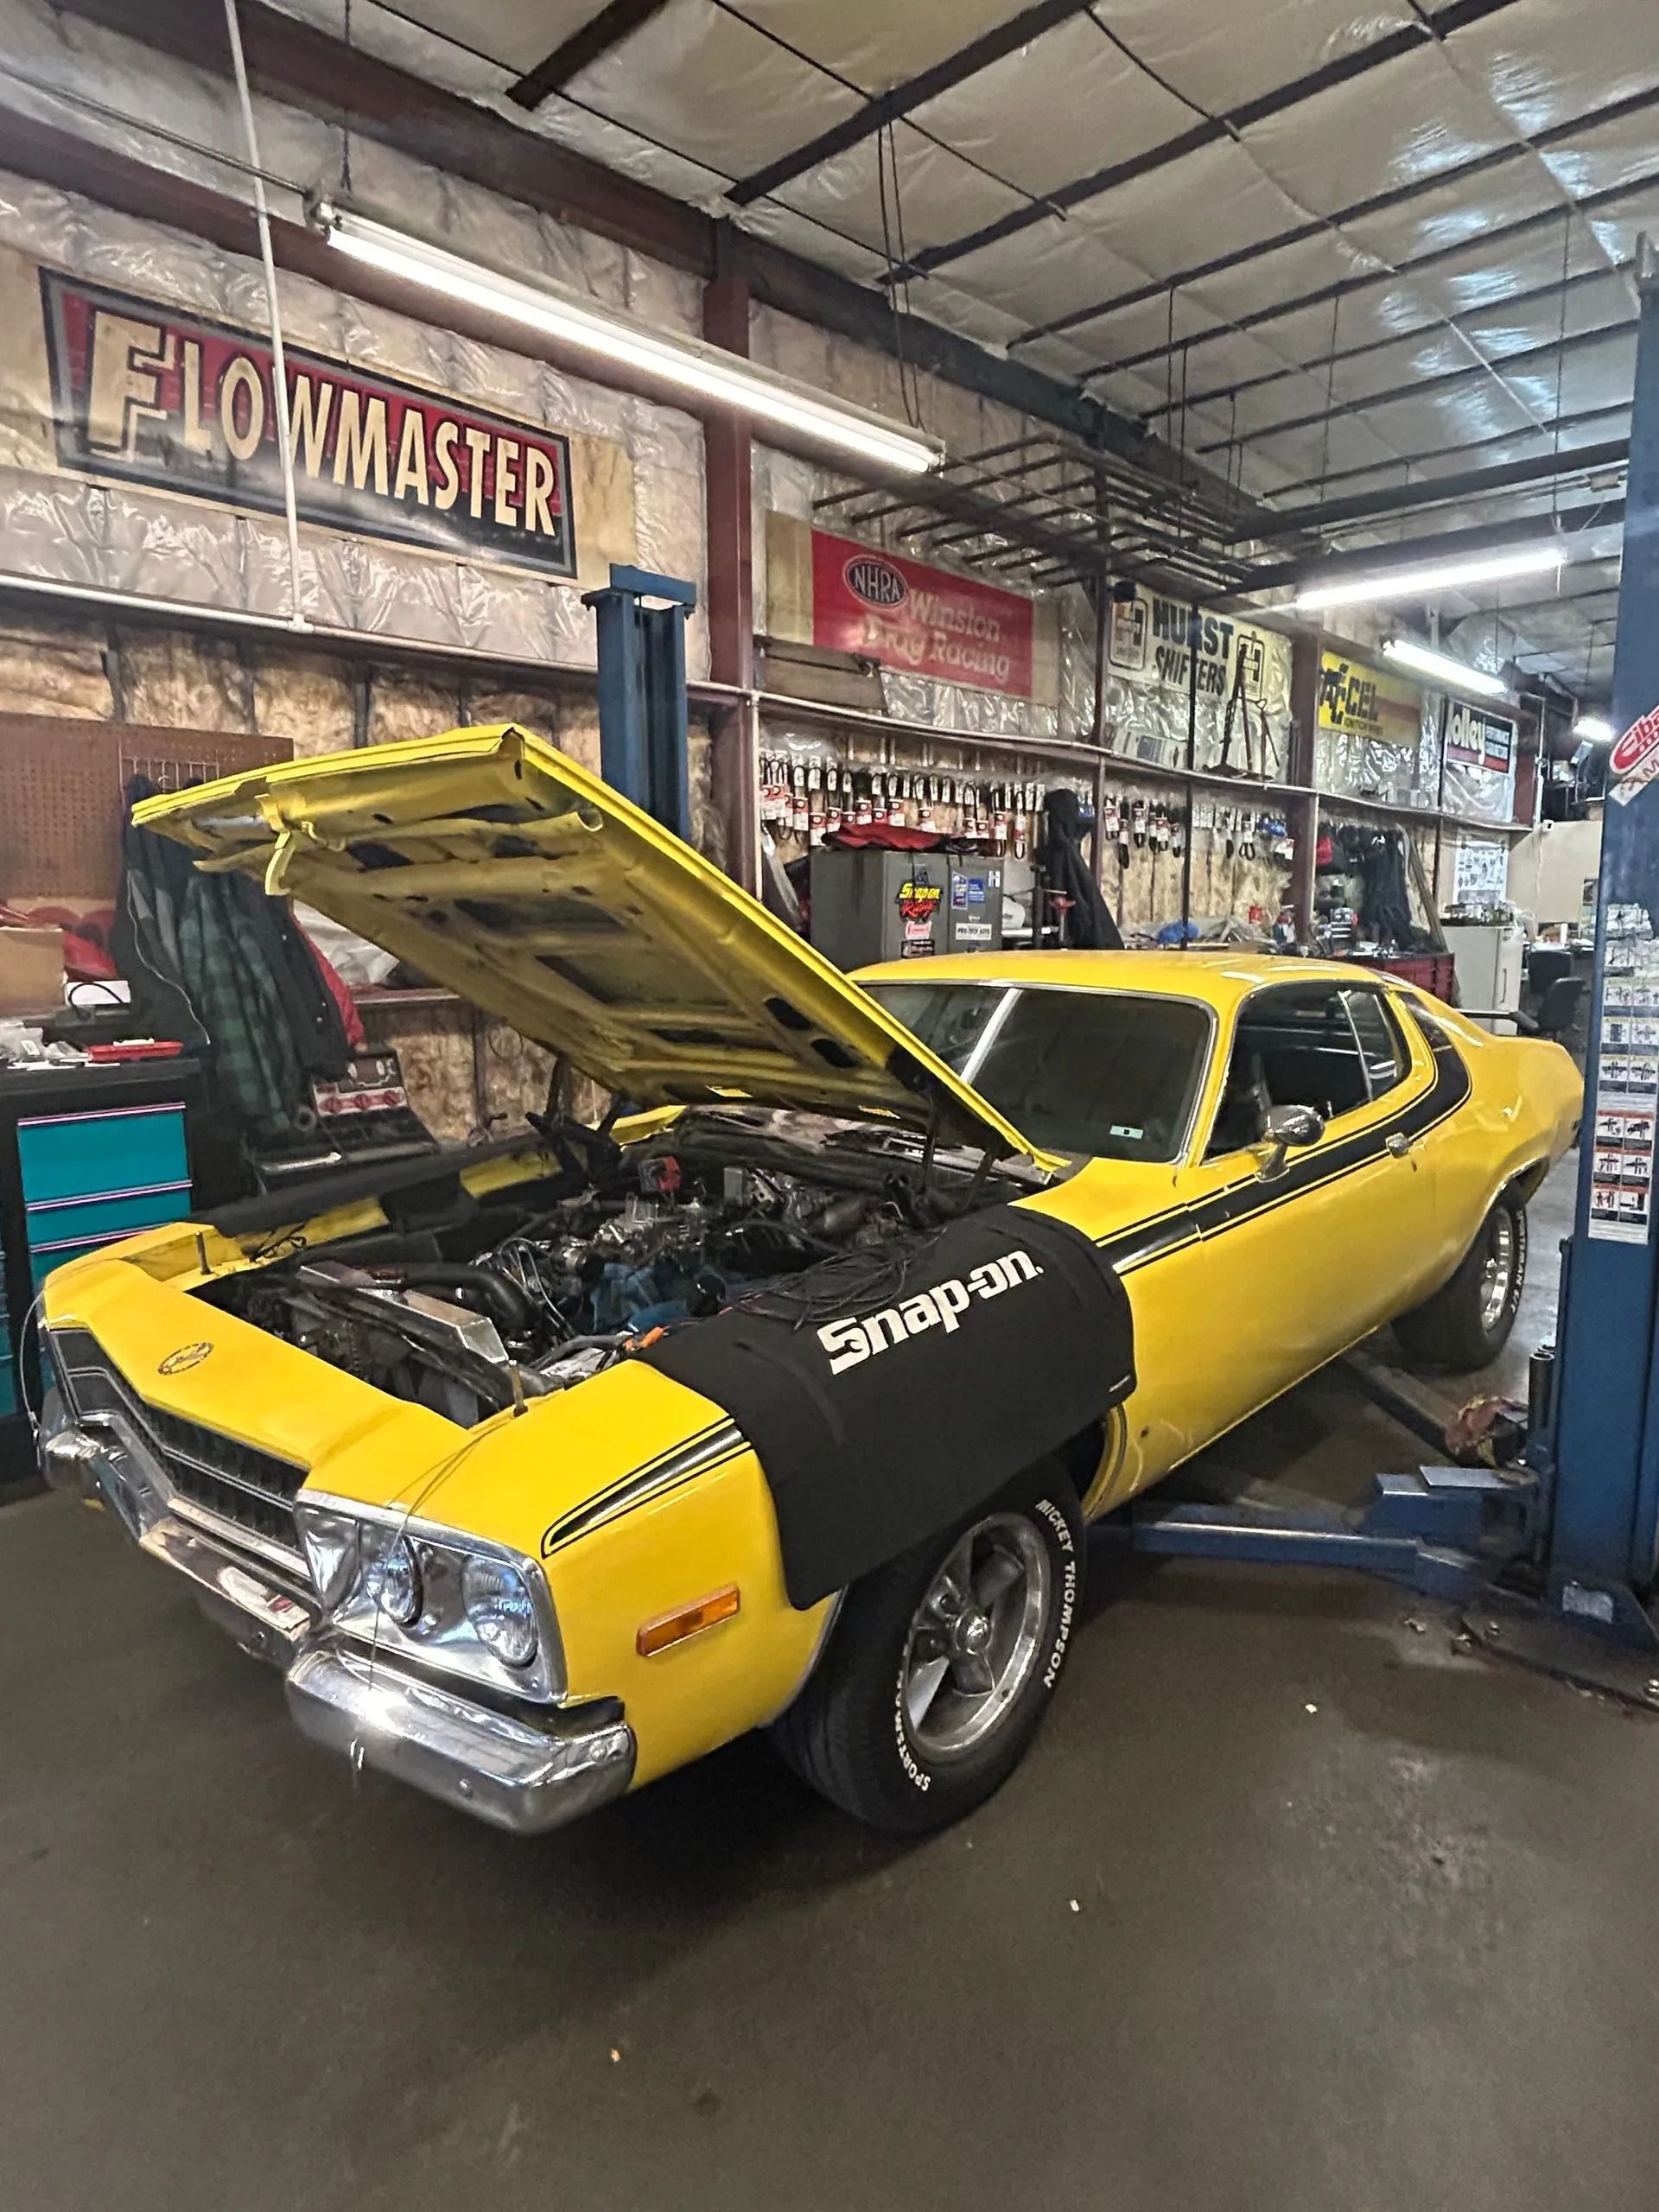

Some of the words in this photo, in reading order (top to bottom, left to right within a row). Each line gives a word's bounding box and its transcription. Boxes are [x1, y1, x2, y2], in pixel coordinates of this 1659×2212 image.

[87, 309, 557, 537] FLOWMASTER
[854, 565, 900, 603] NHRA
[910, 588, 1001, 642] Winston
[864, 613, 926, 665] Drag
[928, 630, 1010, 684] Racing
[1155, 645, 1226, 696] SHIFERS
[1035, 1499, 1074, 1552] MICKEY
[1043, 1560, 1076, 1688] THOMPSON
